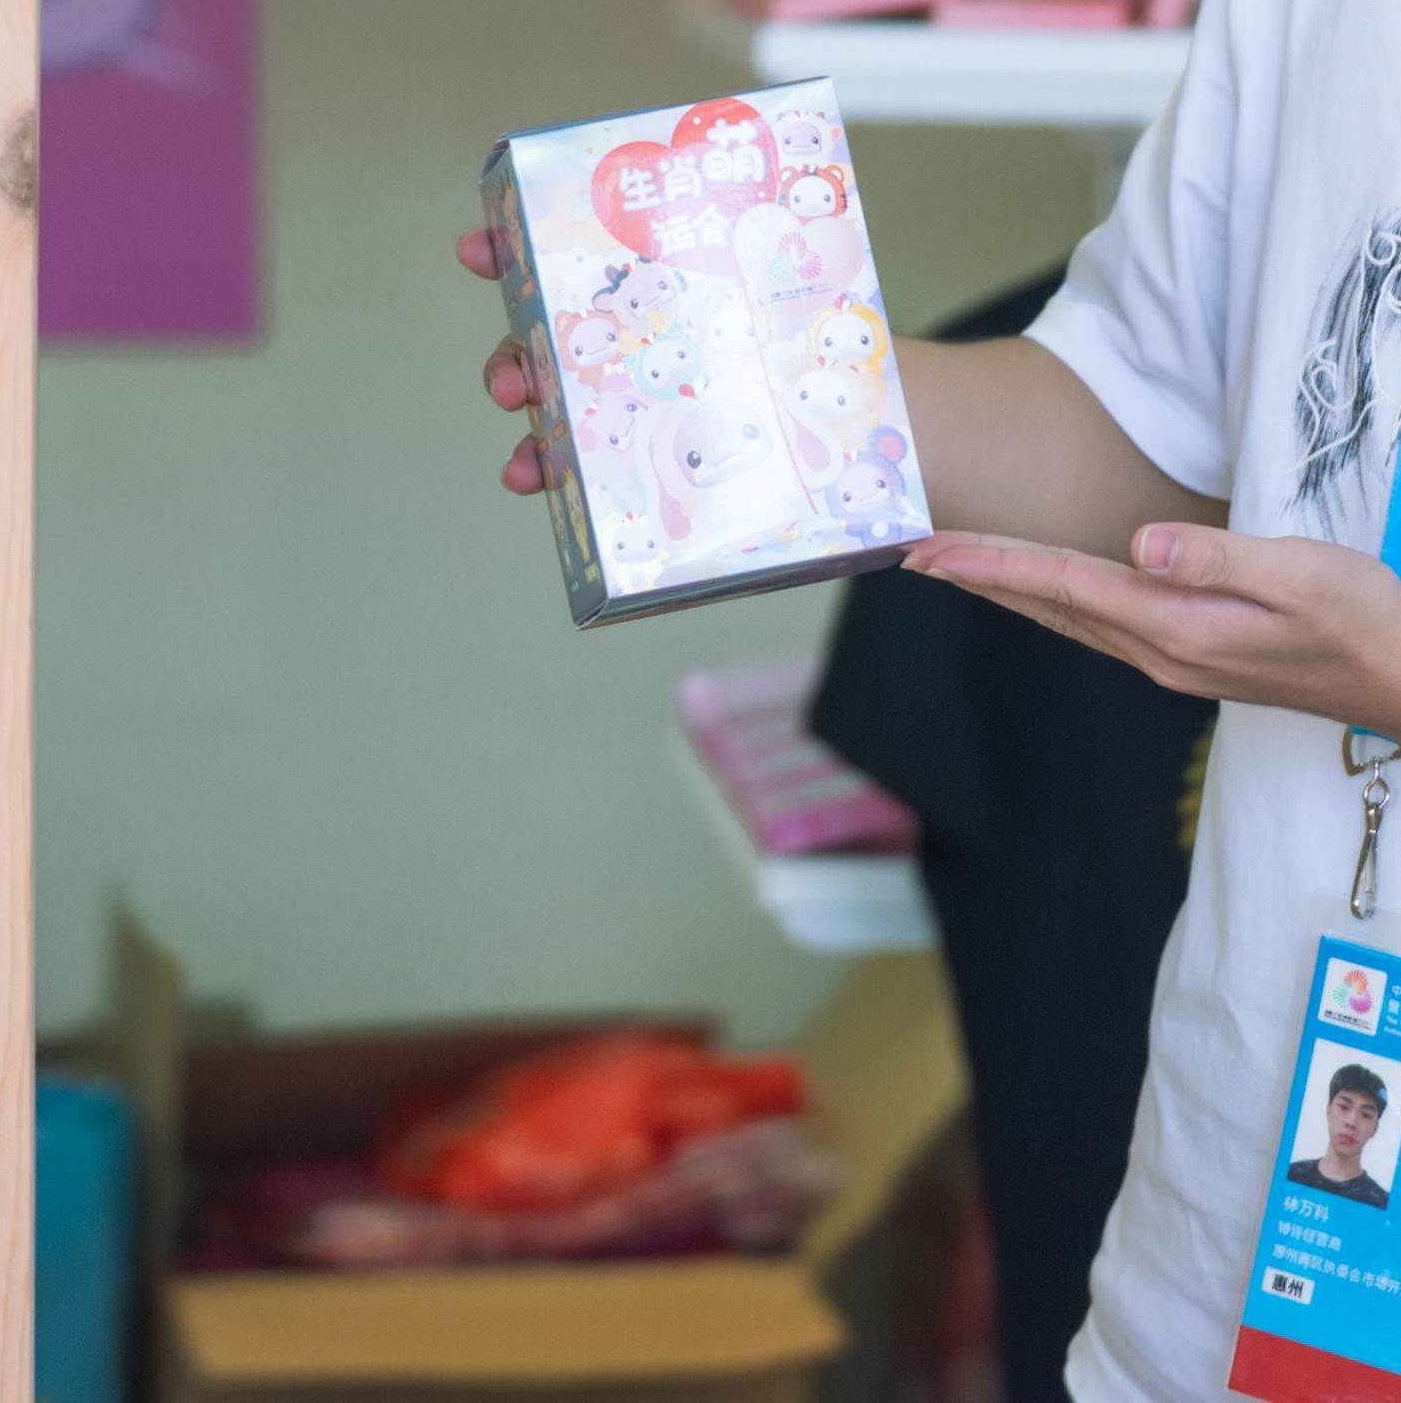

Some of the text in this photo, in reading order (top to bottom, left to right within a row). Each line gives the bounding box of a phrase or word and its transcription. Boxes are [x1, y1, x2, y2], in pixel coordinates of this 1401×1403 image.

[618, 117, 770, 212] 生肖萌
[651, 203, 732, 258] 运会
[1278, 1220, 1342, 1252] 特许经营商
[1271, 1273, 1304, 1298] 惠州
